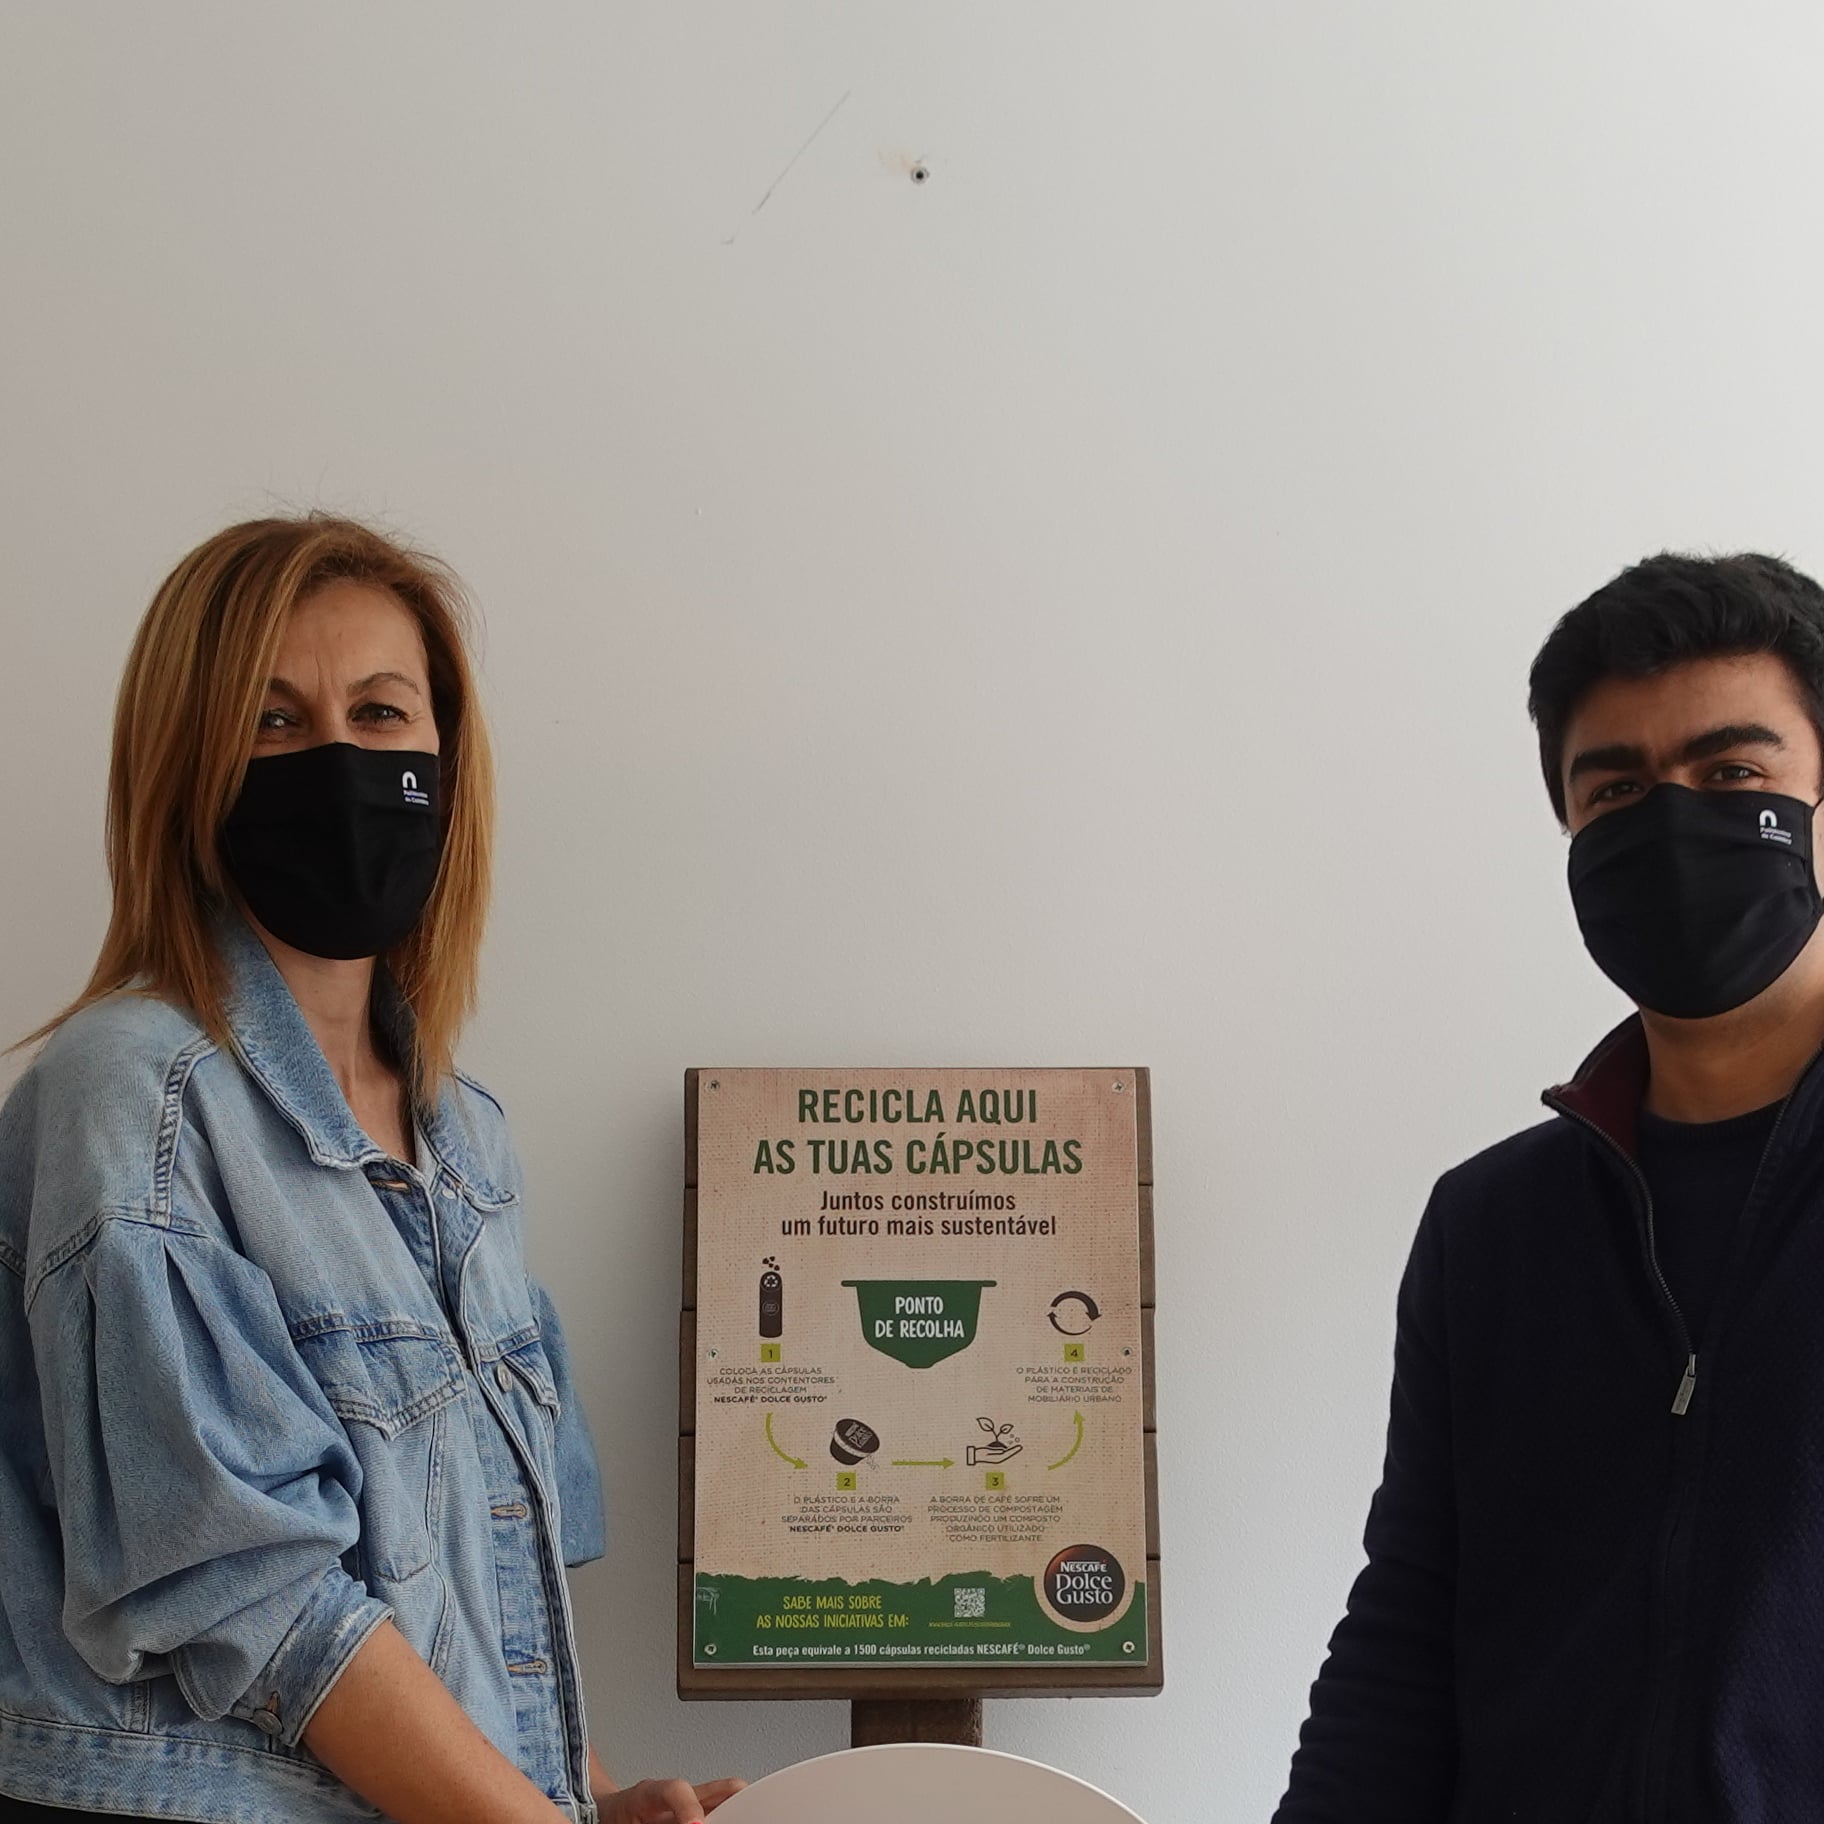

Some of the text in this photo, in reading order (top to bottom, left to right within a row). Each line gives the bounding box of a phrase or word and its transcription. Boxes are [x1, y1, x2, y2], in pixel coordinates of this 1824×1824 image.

[798, 1089, 1037, 1126] RECICLA AQUI
[753, 1132, 1083, 1175] AS TUAS CÁPSULAS
[820, 1190, 1016, 1211] Juntos construímos
[782, 1215, 1057, 1236] um futuro mais sustentável
[894, 1296, 944, 1315] PONTO
[875, 1320, 965, 1338] DE RECOLHA
[746, 1376, 765, 1385] NOS
[734, 1386, 746, 1394] DE
[761, 1396, 791, 1404] DOLCE
[843, 1478, 851, 1487] 2
[991, 1477, 999, 1486] 3
[836, 1525, 868, 1533] DOLCE
[1060, 1559, 1107, 1572] NESCAFÉ
[1056, 1574, 1113, 1591] Dolce
[783, 1594, 882, 1610] SABE MAIS SOBRE
[1056, 1588, 1113, 1605] Gusto
[756, 1614, 909, 1629] AS NOSSAS INICIATIVAS EM:
[753, 1645, 773, 1657] Esta
[776, 1646, 799, 1659] peça
[802, 1644, 842, 1658] equivale
[844, 1647, 851, 1656] a
[854, 1644, 877, 1656] 1500
[879, 1644, 922, 1658] cápsulas
[924, 1644, 974, 1656] recicladas
[1028, 1644, 1054, 1656] Dolce
